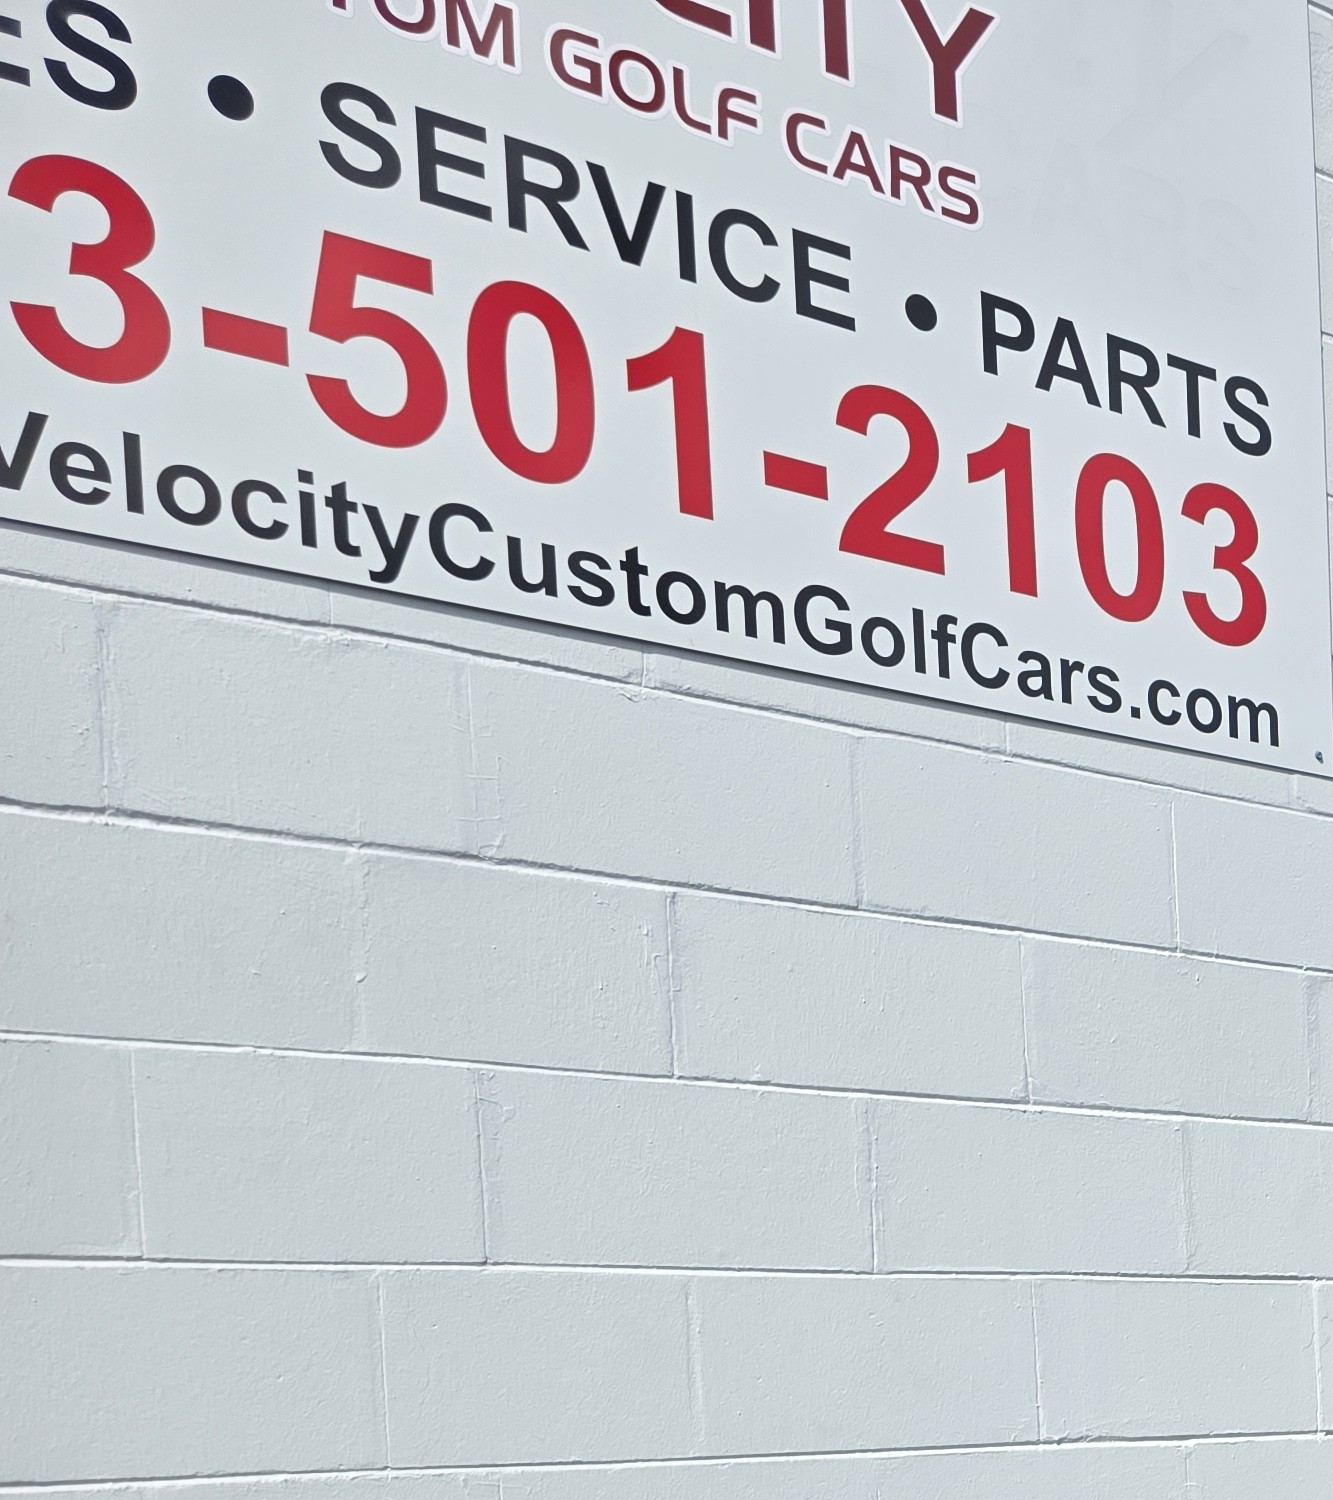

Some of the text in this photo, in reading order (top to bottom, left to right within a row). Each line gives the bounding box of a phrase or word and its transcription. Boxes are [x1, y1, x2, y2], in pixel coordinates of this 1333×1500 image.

[318, 82, 855, 331] SERVICE
[980, 291, 1272, 457] PARTS
[549, 29, 757, 140] GOLF
[785, 112, 979, 224] CARS
[8, 154, 1268, 647] 3-501-2103
[0, 411, 1280, 748] VelocityCustomGolfCars.com
